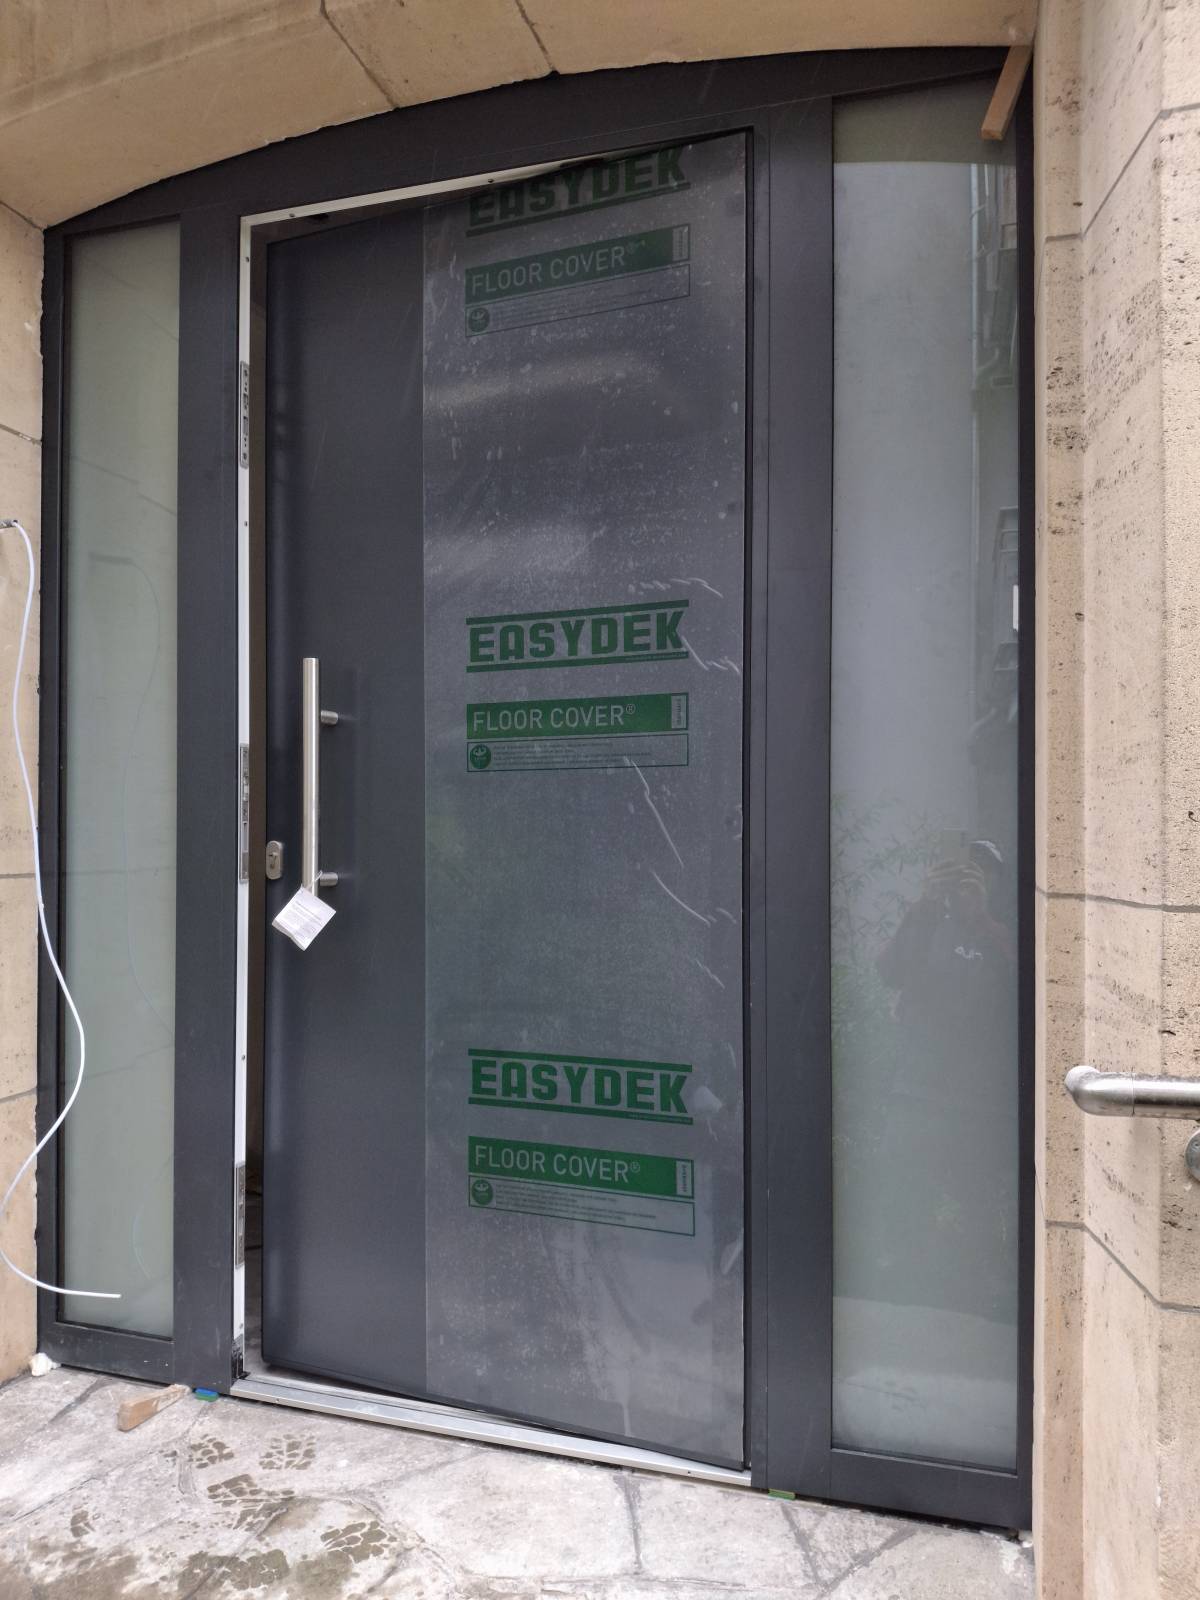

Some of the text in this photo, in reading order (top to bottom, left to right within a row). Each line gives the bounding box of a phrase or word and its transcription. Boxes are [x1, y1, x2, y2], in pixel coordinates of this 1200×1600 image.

[469, 147, 686, 227] EASYDEK
[471, 262, 542, 297] FLOOR
[469, 610, 684, 663] EASYDEK
[473, 709, 543, 732] FLOOR
[471, 1058, 688, 1114] EASYDEK
[475, 1144, 545, 1174] FLOOR
